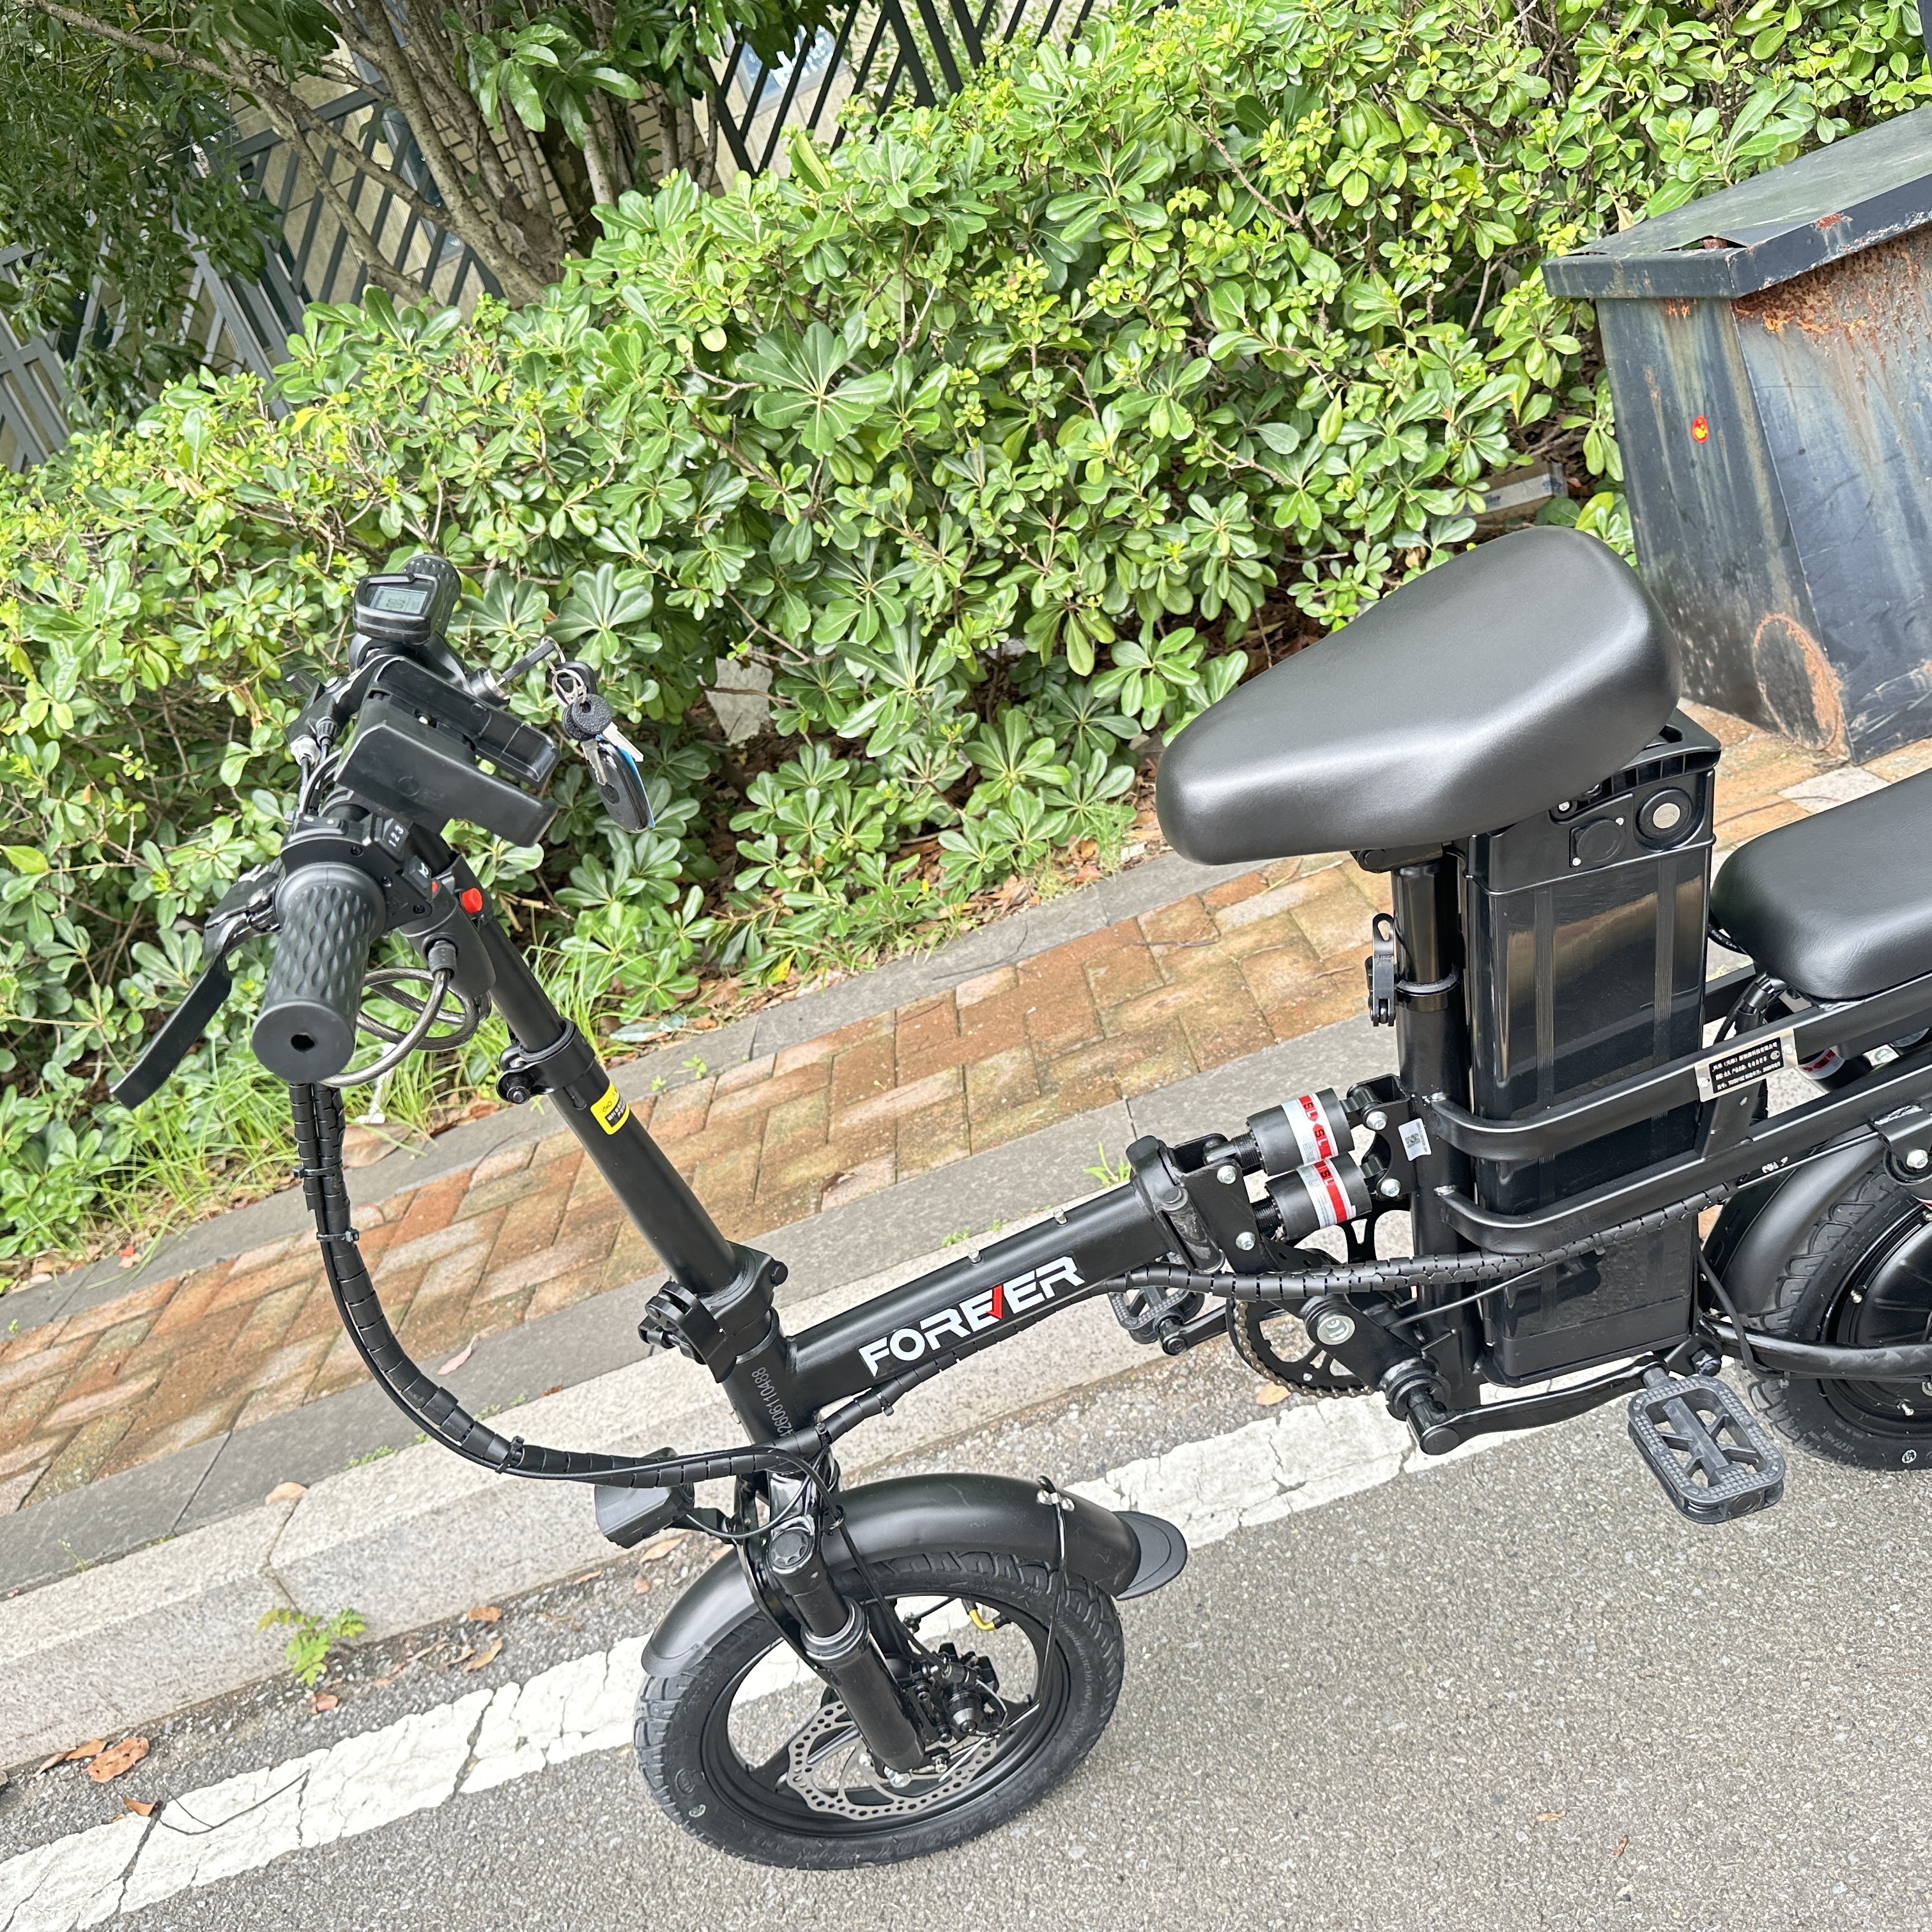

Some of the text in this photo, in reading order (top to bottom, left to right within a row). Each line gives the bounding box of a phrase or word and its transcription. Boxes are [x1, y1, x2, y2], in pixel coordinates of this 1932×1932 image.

[1303, 1101, 1317, 1118] SL
[1314, 1128, 1327, 1147] SL
[1319, 1170, 1335, 1186] SL
